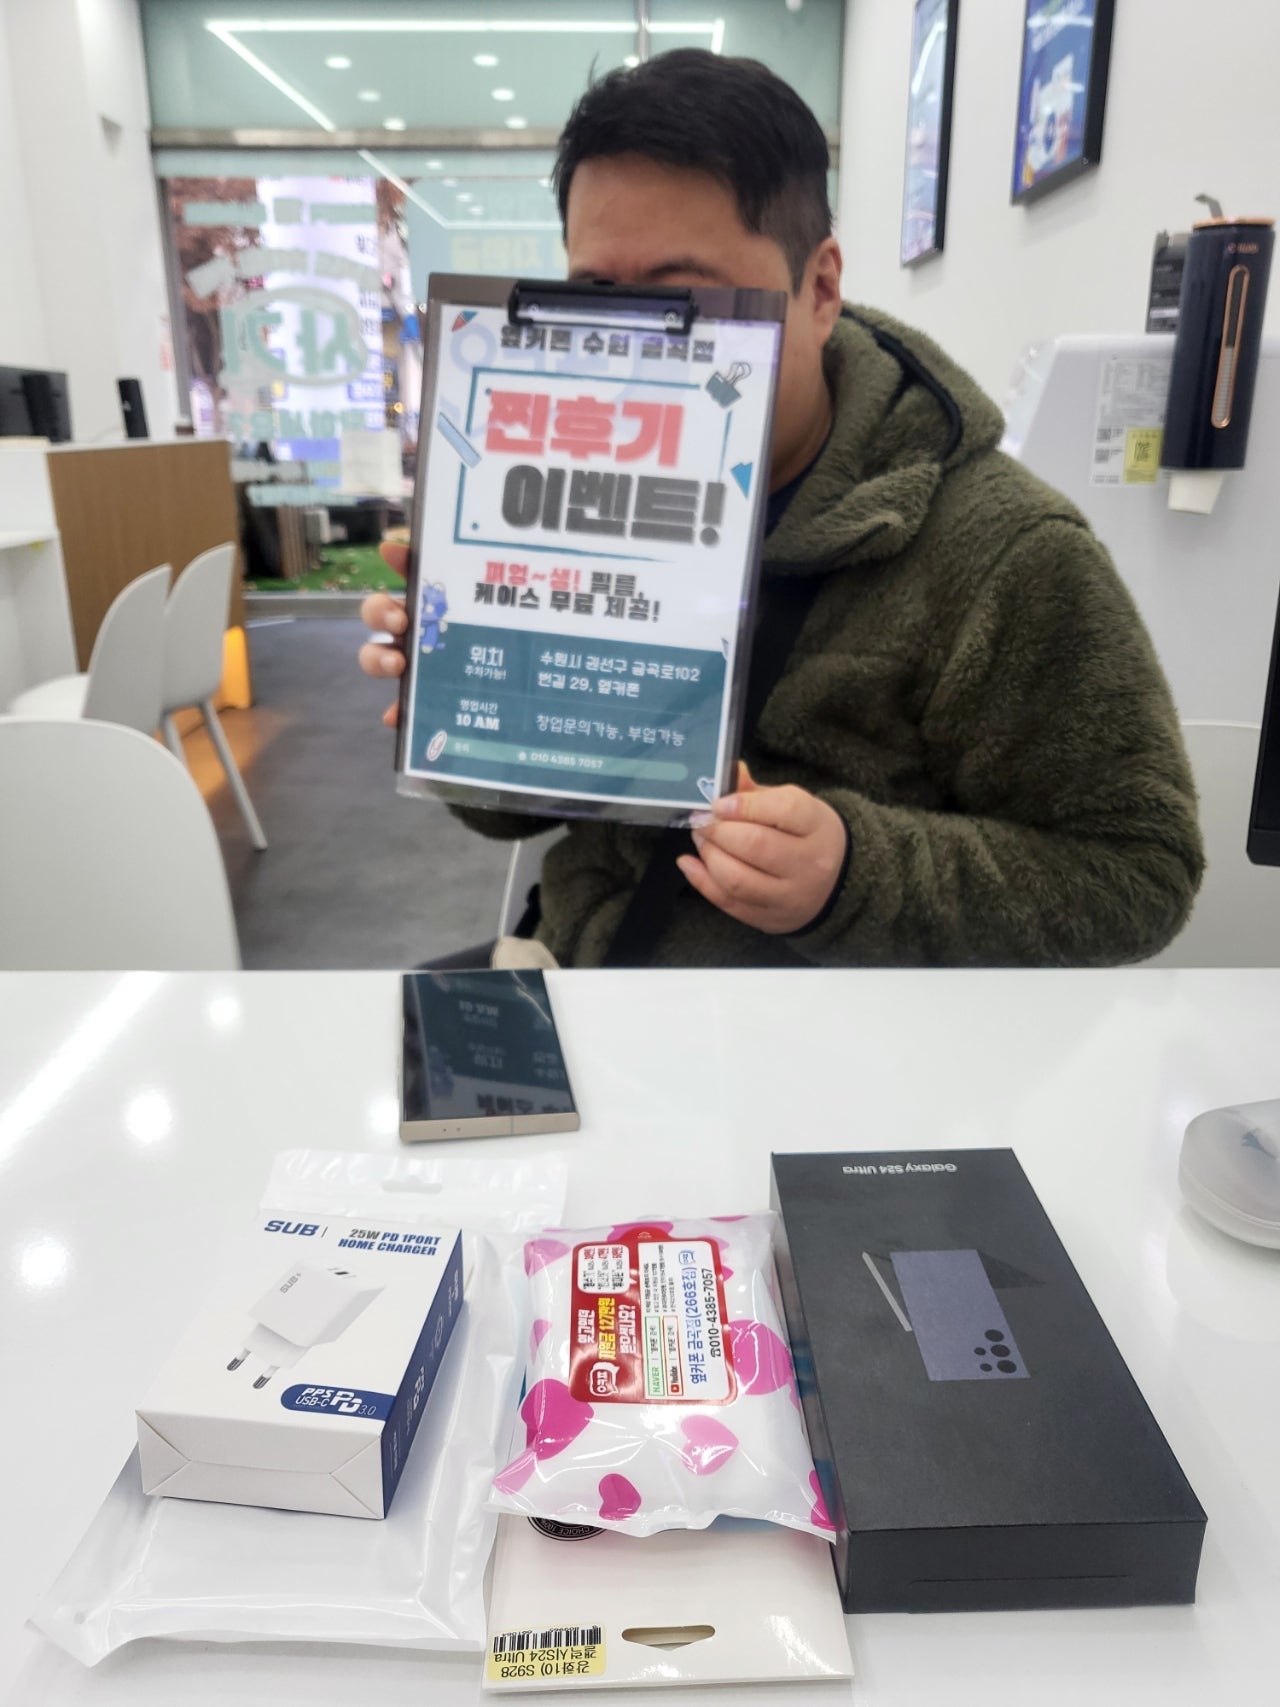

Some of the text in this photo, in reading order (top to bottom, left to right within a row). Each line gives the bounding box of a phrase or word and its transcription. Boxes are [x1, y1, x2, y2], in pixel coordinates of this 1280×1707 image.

[485, 390, 685, 468] 찐후기
[501, 464, 727, 547] 이벤트!
[474, 582, 661, 622] 케이스 무료 제공!
[470, 646, 504, 667] 위치
[540, 651, 700, 682] 수원시 권선구 금곡로102
[538, 671, 566, 690] 번길
[460, 699, 498, 715] 영업시간
[456, 713, 500, 731] 10 AM
[627, 726, 686, 747] 부업가능
[531, 752, 549, 763] 010
[842, 1162, 958, 1175] Galaxy S24 Ultra
[264, 1220, 320, 1237] SUB
[349, 1228, 442, 1247] 25W PD 1PORT
[338, 1238, 438, 1256] HOME CHARGER
[688, 1353, 707, 1384] 옆커폰
[650, 1367, 661, 1393] NAVER
[295, 1396, 330, 1407] USB-C
[302, 1387, 335, 1399] PPS
[330, 1391, 376, 1416] PD 3.0
[557, 1526, 590, 1536] CHOICE
[494, 1646, 597, 1663] 갤럭시S24 Ultra
[501, 1660, 590, 1678] 강화10) S928
